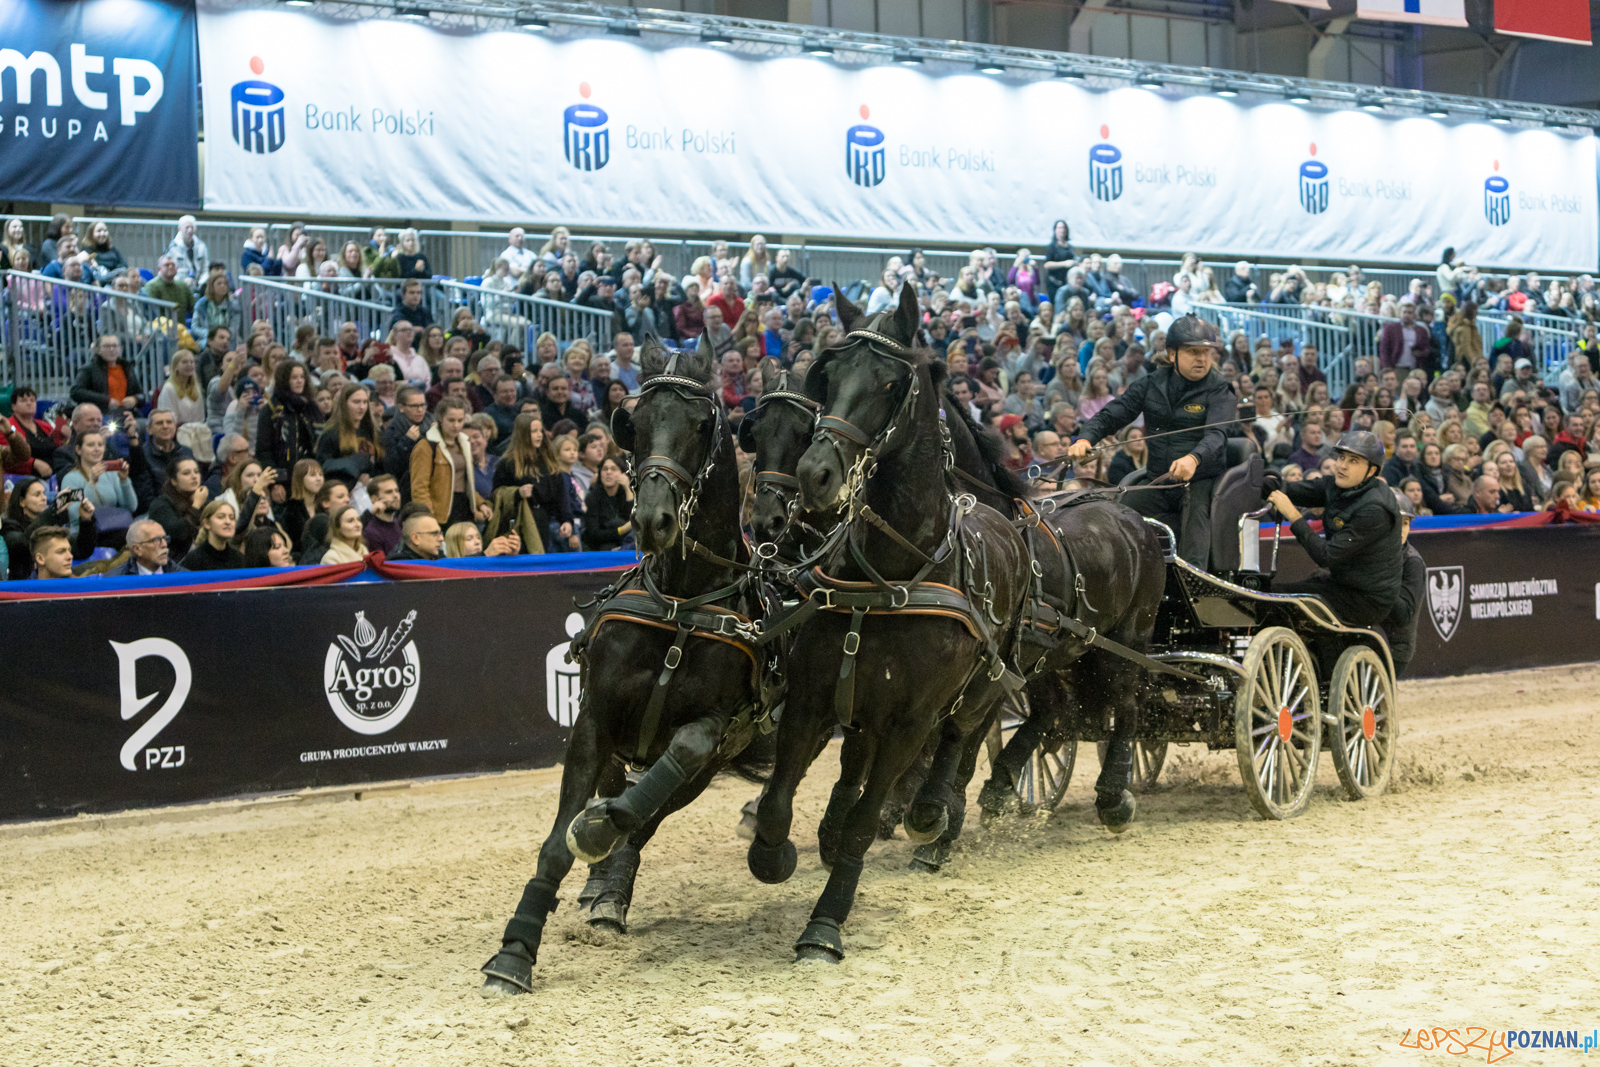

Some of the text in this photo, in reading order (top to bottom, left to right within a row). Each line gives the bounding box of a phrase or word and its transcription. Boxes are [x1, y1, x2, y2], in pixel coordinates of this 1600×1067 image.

[0, 43, 164, 126] mtp
[0, 115, 109, 142] RUPA
[305, 103, 362, 132] Bank
[372, 108, 435, 137] Polski
[626, 124, 673, 151] Bank
[682, 128, 736, 154] Polski
[901, 144, 942, 168] Bank
[949, 147, 995, 171] Polski
[1137, 163, 1170, 184] Bank
[1177, 165, 1216, 187] Polski
[1339, 178, 1372, 198] Bank
[1376, 181, 1412, 201] Polski
[1519, 192, 1547, 211] Bank
[1551, 194, 1582, 214] Polski
[1470, 599, 1532, 619] WIELKOPOLSKIEGO
[329, 660, 415, 701] Agros
[356, 704, 368, 713] sp.
[146, 745, 185, 769] PZJ
[300, 739, 449, 763] GRUPA PRODUCENTÓW WARZYW
